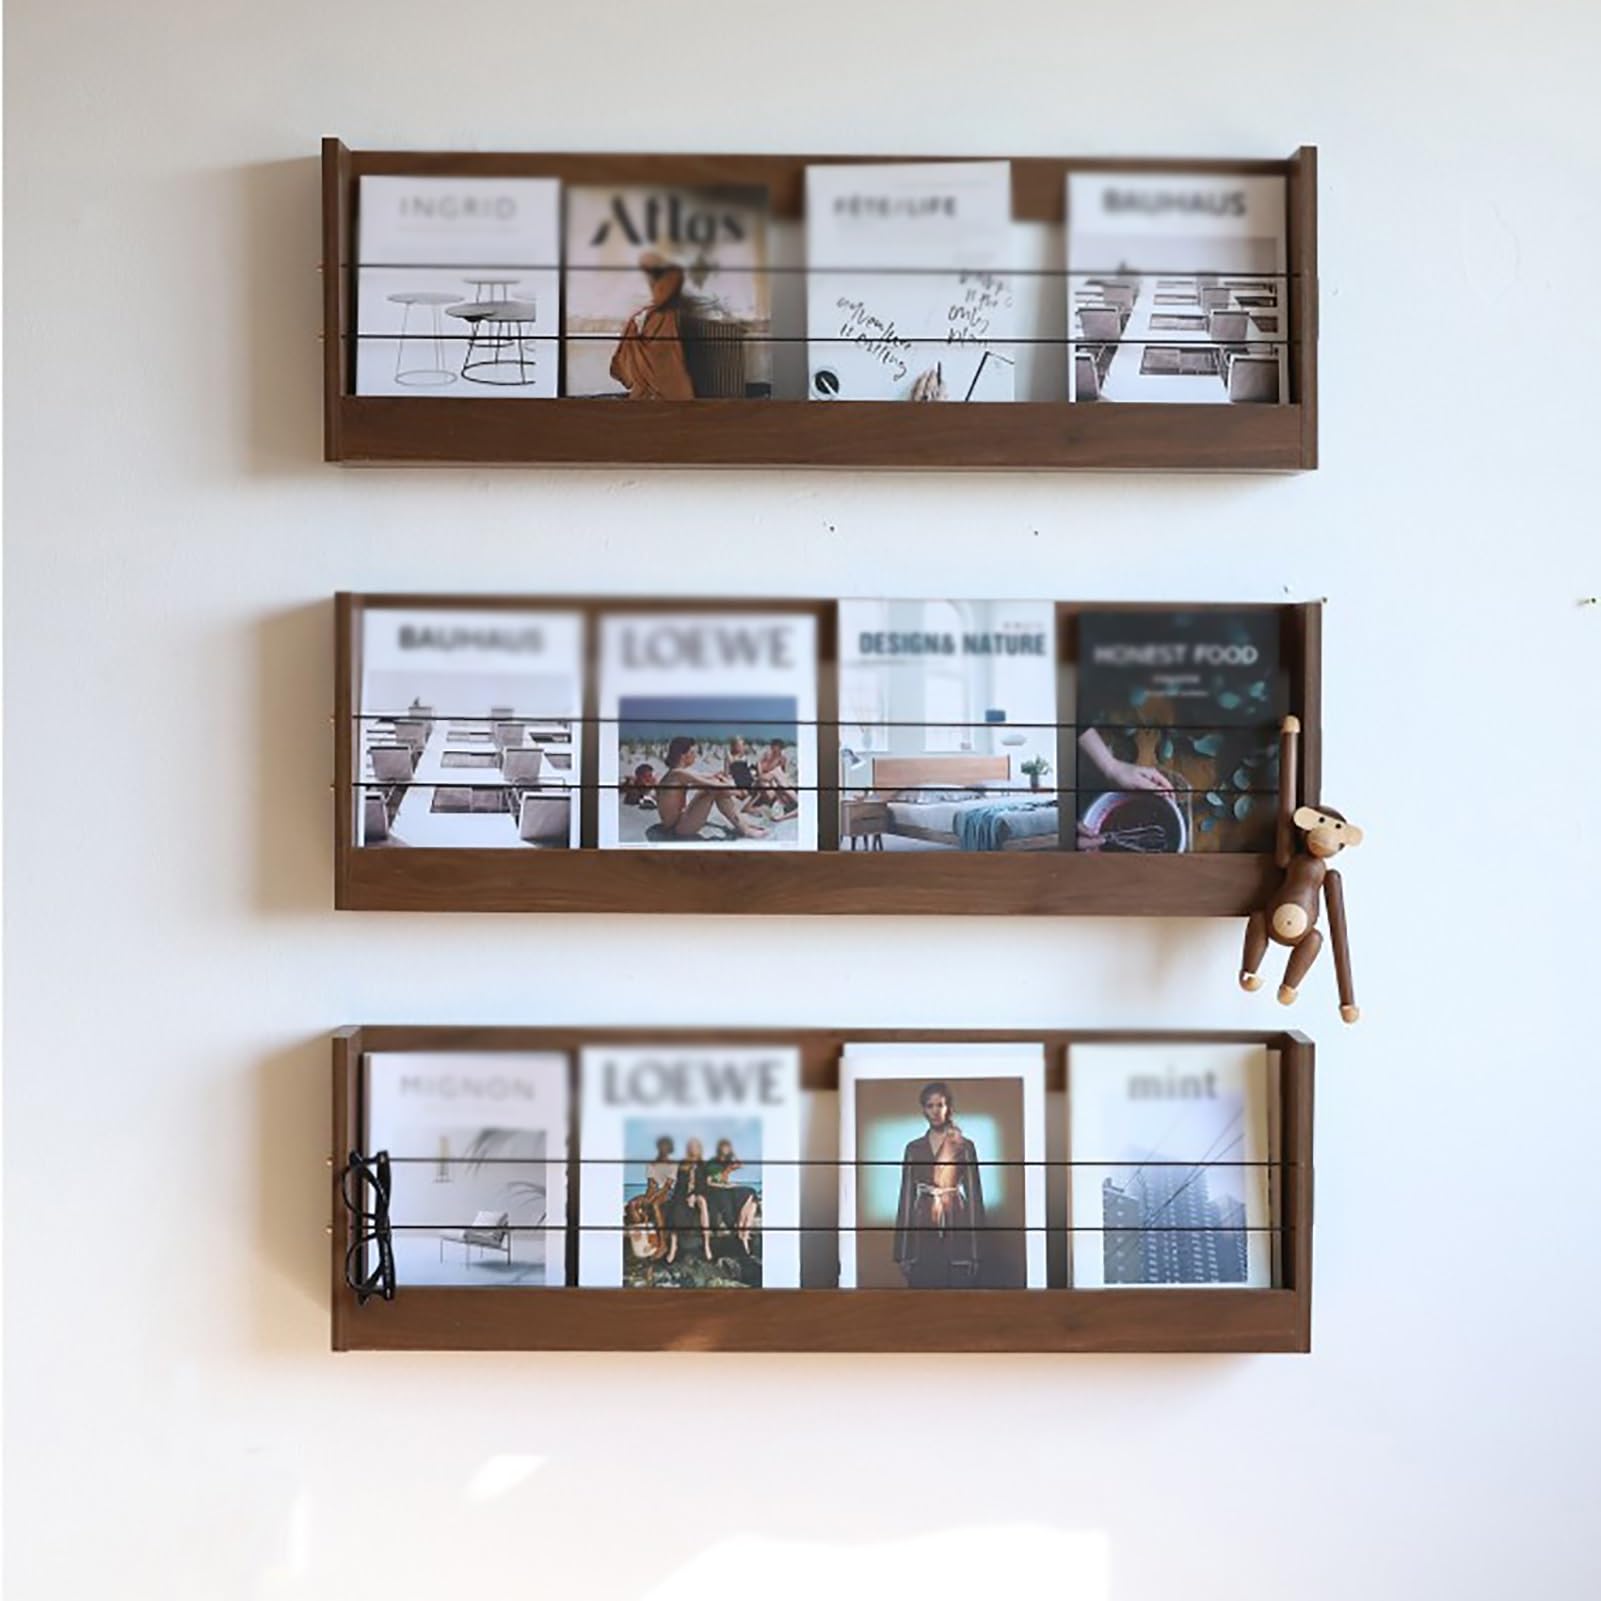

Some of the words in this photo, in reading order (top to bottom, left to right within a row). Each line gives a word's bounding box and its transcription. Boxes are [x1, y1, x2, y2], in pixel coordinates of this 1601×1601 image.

[399, 195, 518, 220] INGRID
[1102, 188, 1247, 217] BAUHAUS
[398, 624, 544, 652] BAUHAUS
[620, 625, 796, 669] LOEWE
[961, 631, 1046, 657] NATURE
[1093, 642, 1187, 666] HONEST
[1193, 642, 1259, 666] FOOD
[400, 1075, 535, 1101] MIGNON
[603, 1059, 784, 1106] LOEWE
[1127, 1064, 1217, 1101] mint
